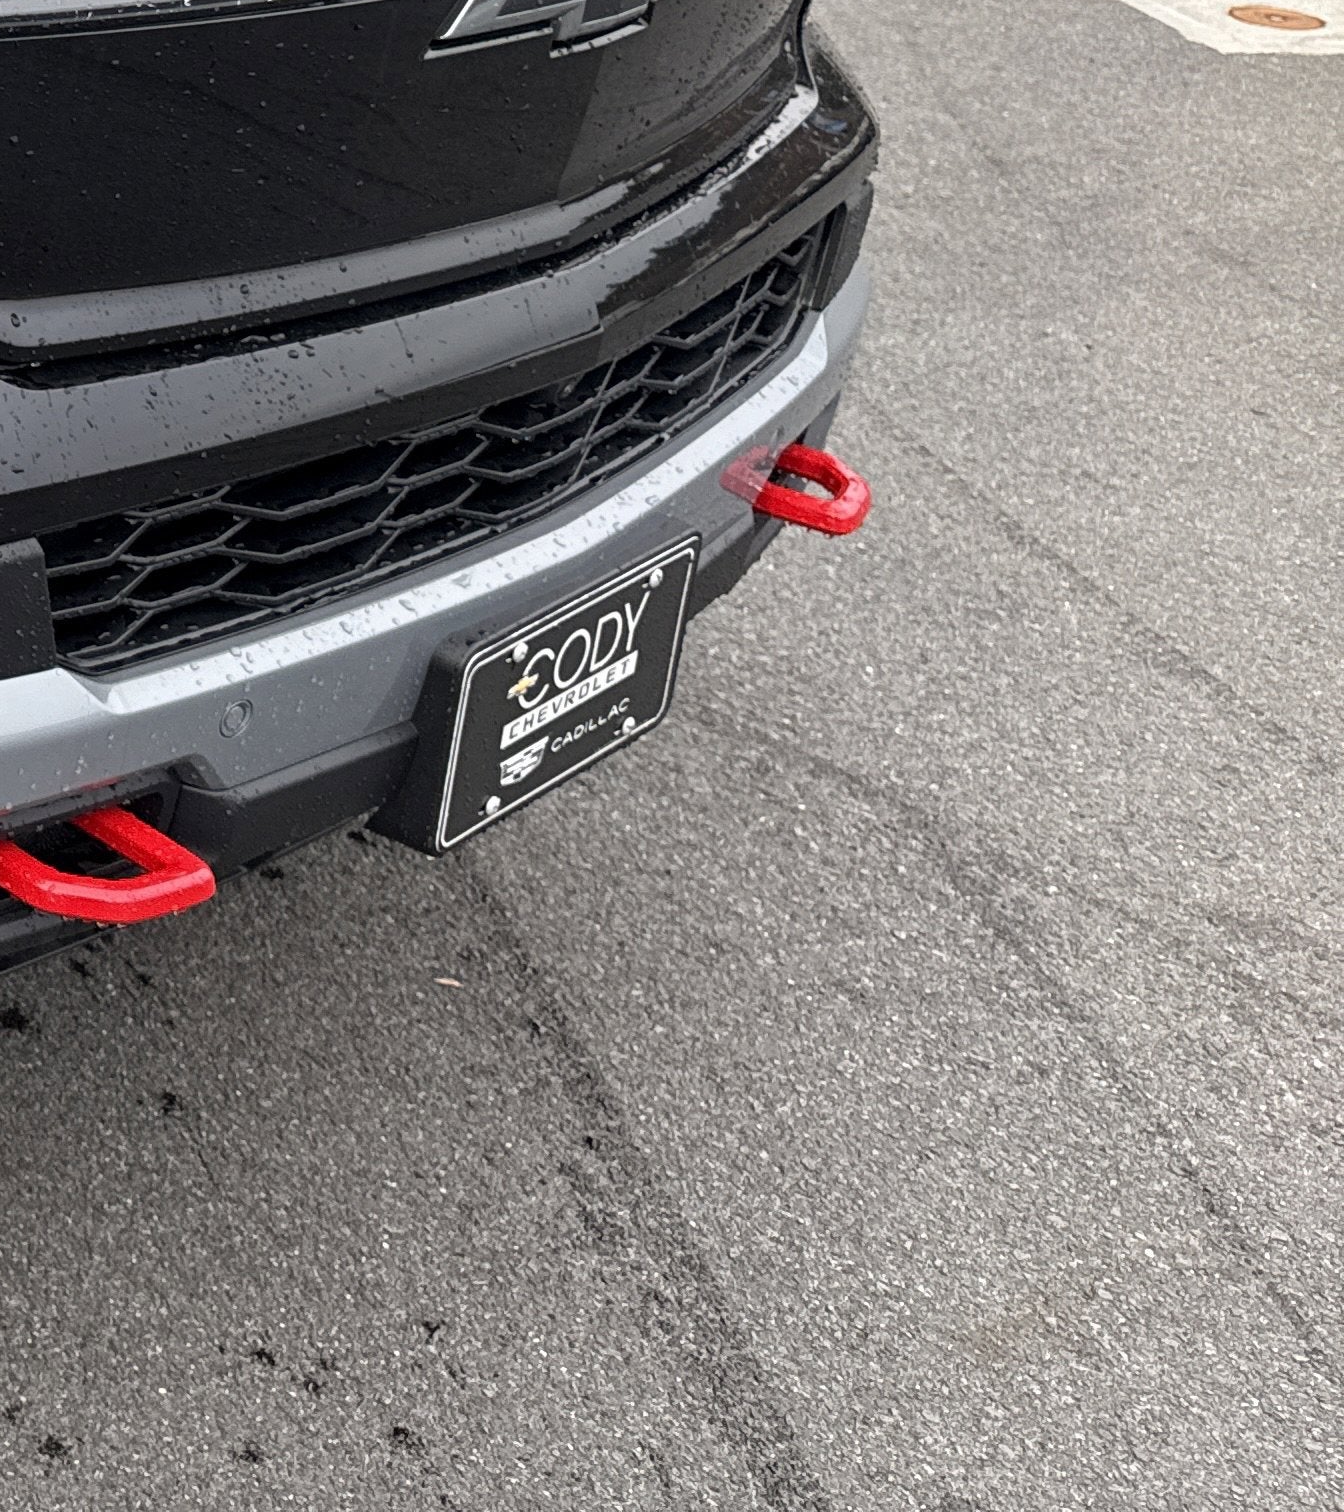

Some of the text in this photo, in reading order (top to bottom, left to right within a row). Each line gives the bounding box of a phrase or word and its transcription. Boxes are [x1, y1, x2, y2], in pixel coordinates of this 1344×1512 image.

[517, 591, 651, 710] CODY
[508, 658, 632, 740] CHEVROLET
[550, 697, 631, 753] CADILLAC
